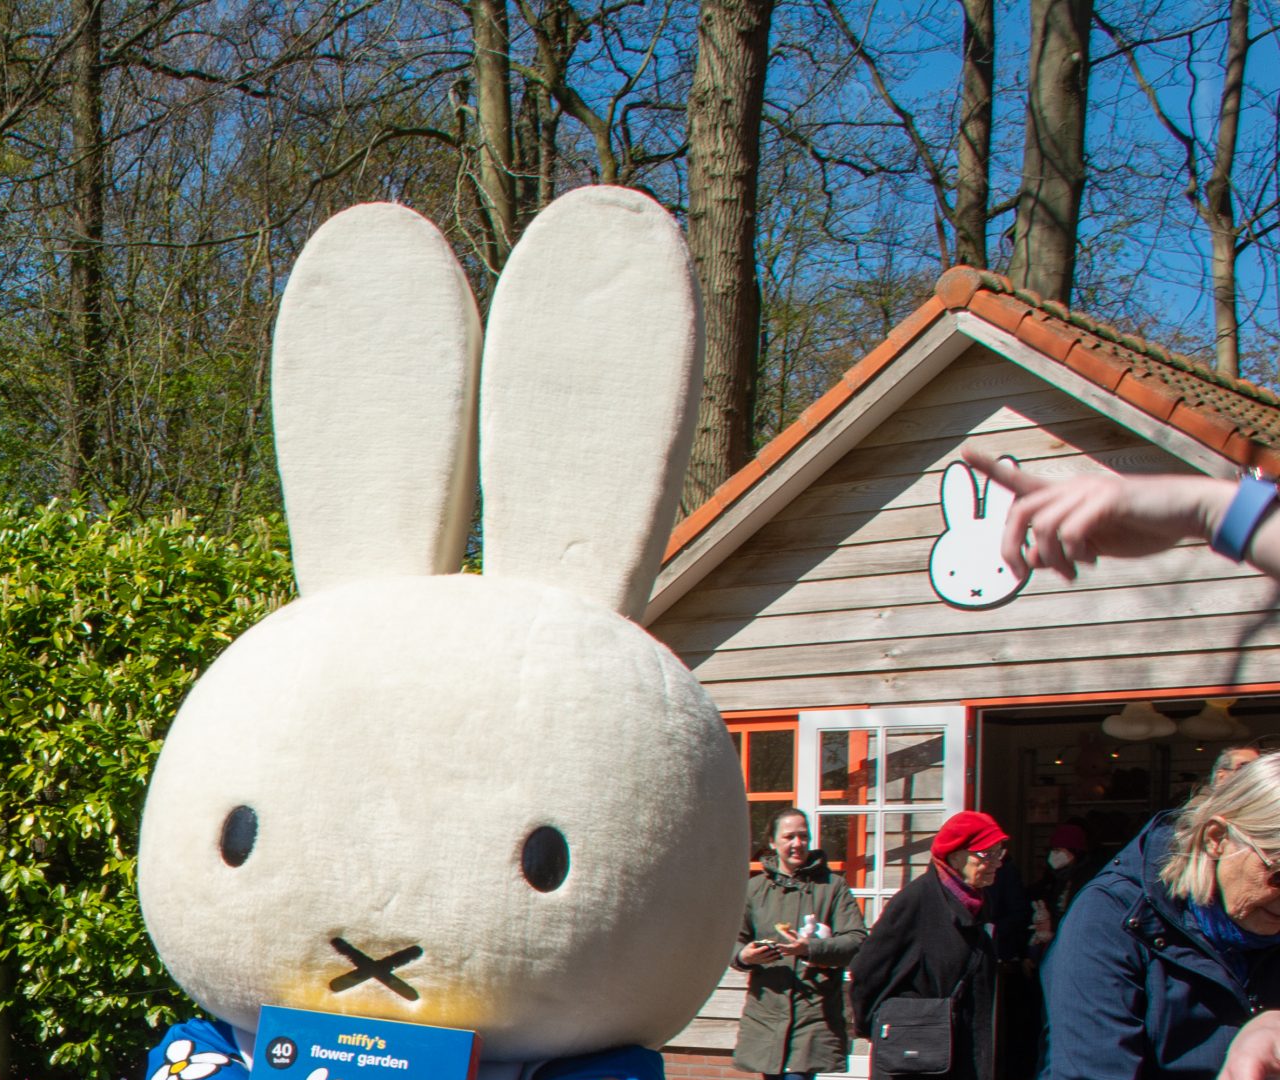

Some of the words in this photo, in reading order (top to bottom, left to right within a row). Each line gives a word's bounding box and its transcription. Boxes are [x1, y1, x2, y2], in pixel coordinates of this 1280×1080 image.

[271, 1043, 293, 1057] 40
[337, 1033, 386, 1050] miffy's
[310, 1045, 355, 1062] flower
[357, 1053, 408, 1069] garden
